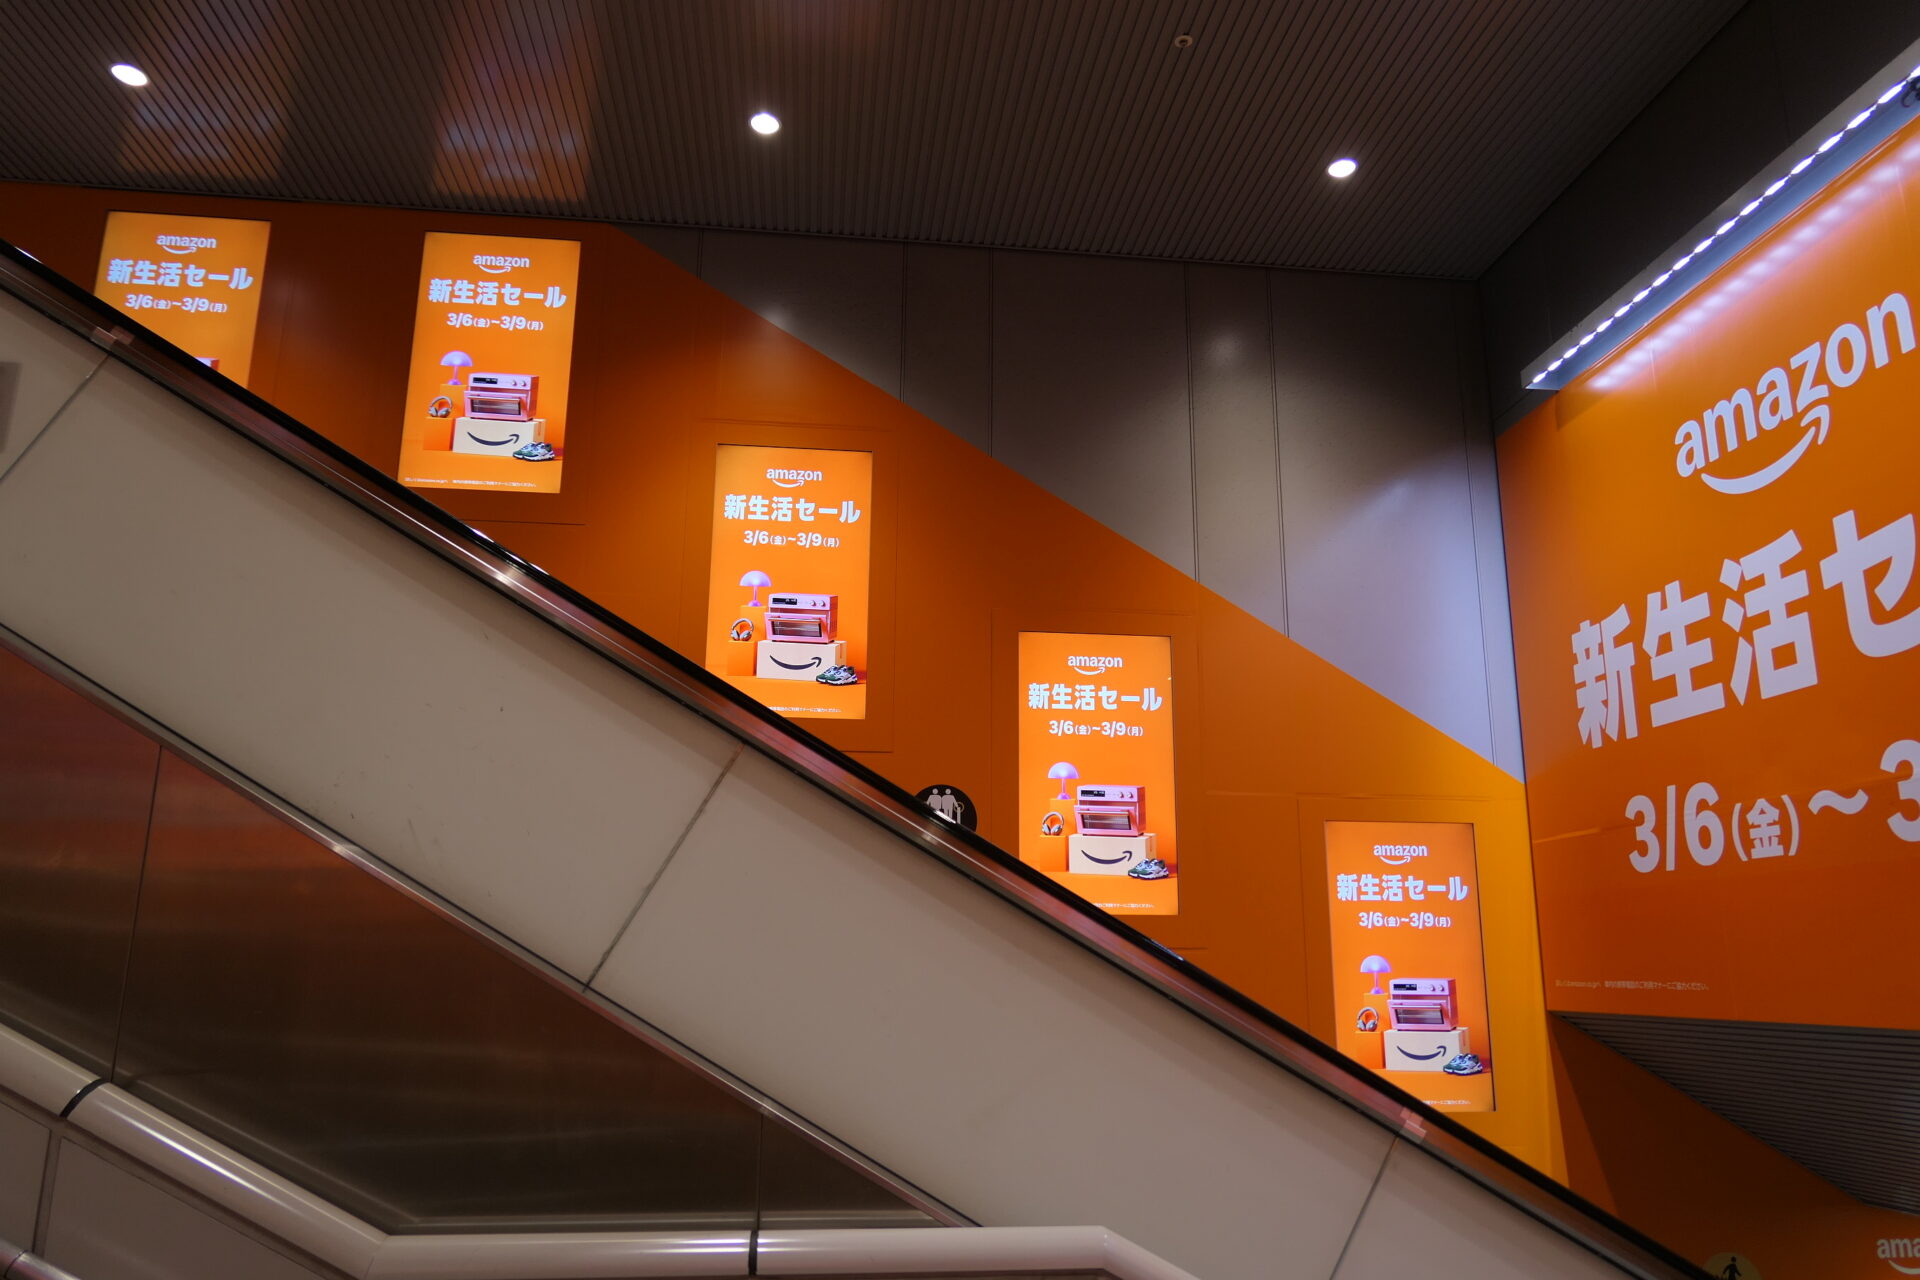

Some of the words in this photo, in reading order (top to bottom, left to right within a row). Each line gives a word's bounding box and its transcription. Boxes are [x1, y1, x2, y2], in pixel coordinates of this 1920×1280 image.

[156, 234, 217, 251] amazon
[107, 259, 254, 290] 新生活セール
[473, 254, 530, 270] amazon
[428, 278, 567, 308] 新生活セール
[1675, 292, 1916, 478] amazon
[766, 468, 823, 485] amazon
[724, 494, 860, 523] 新生活セール
[1571, 509, 1920, 749] 新生活セ
[1068, 656, 1123, 671] amazon
[1029, 683, 1163, 711] 新生活セール
[1373, 844, 1428, 859] amazon
[1337, 874, 1469, 902] 新生活セール
